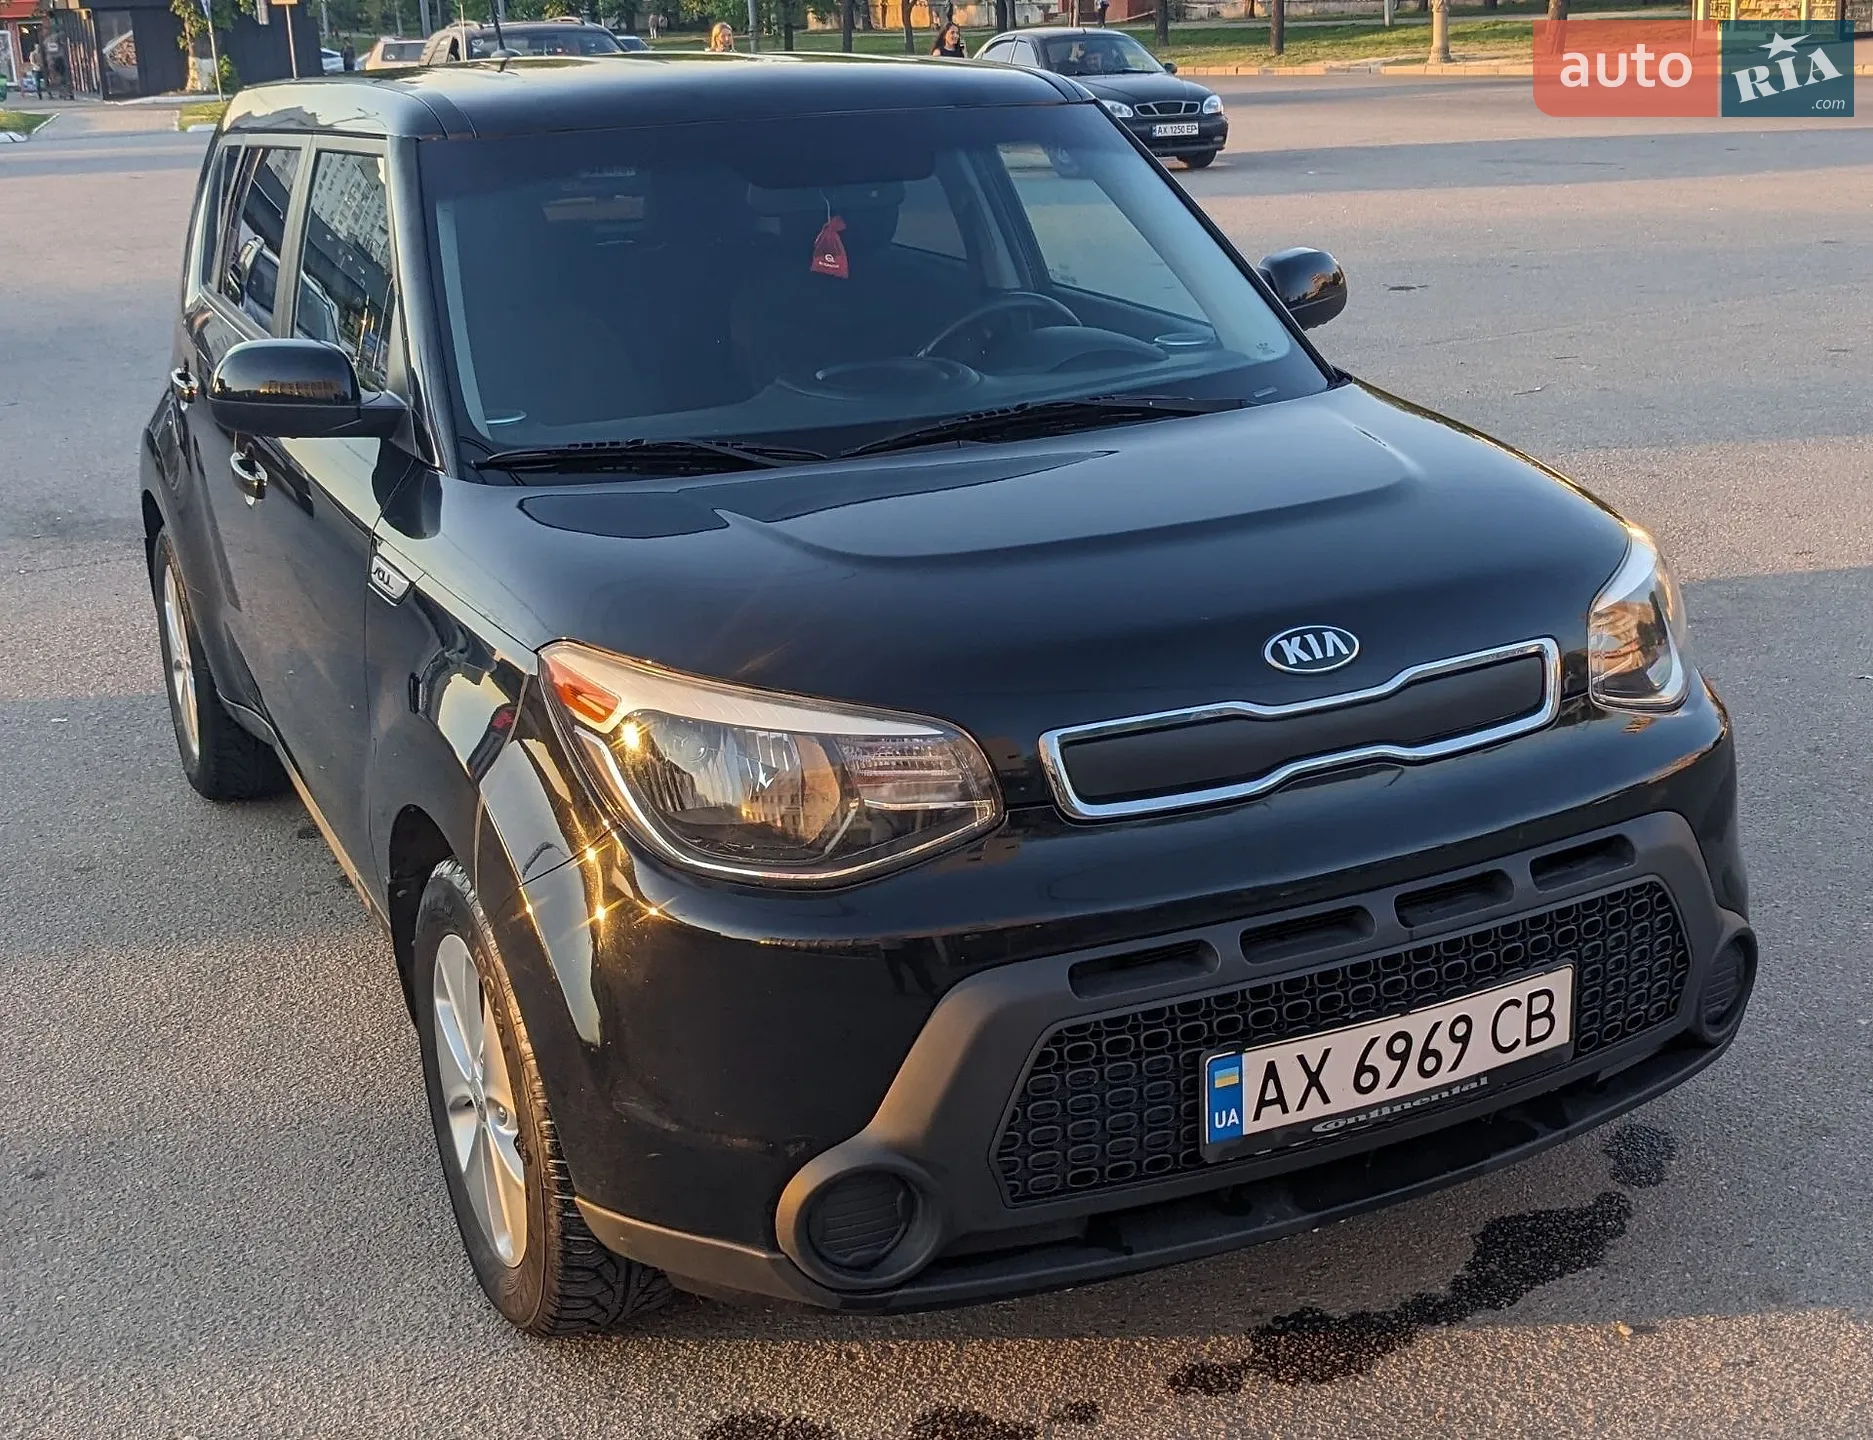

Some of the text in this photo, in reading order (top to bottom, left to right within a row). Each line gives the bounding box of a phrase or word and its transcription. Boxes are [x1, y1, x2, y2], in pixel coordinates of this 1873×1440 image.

[1158, 126, 1168, 135] AX
[1277, 631, 1350, 665] KIA
[1252, 988, 1556, 1122] AX 6969 CB
[1214, 1107, 1239, 1129] UA
